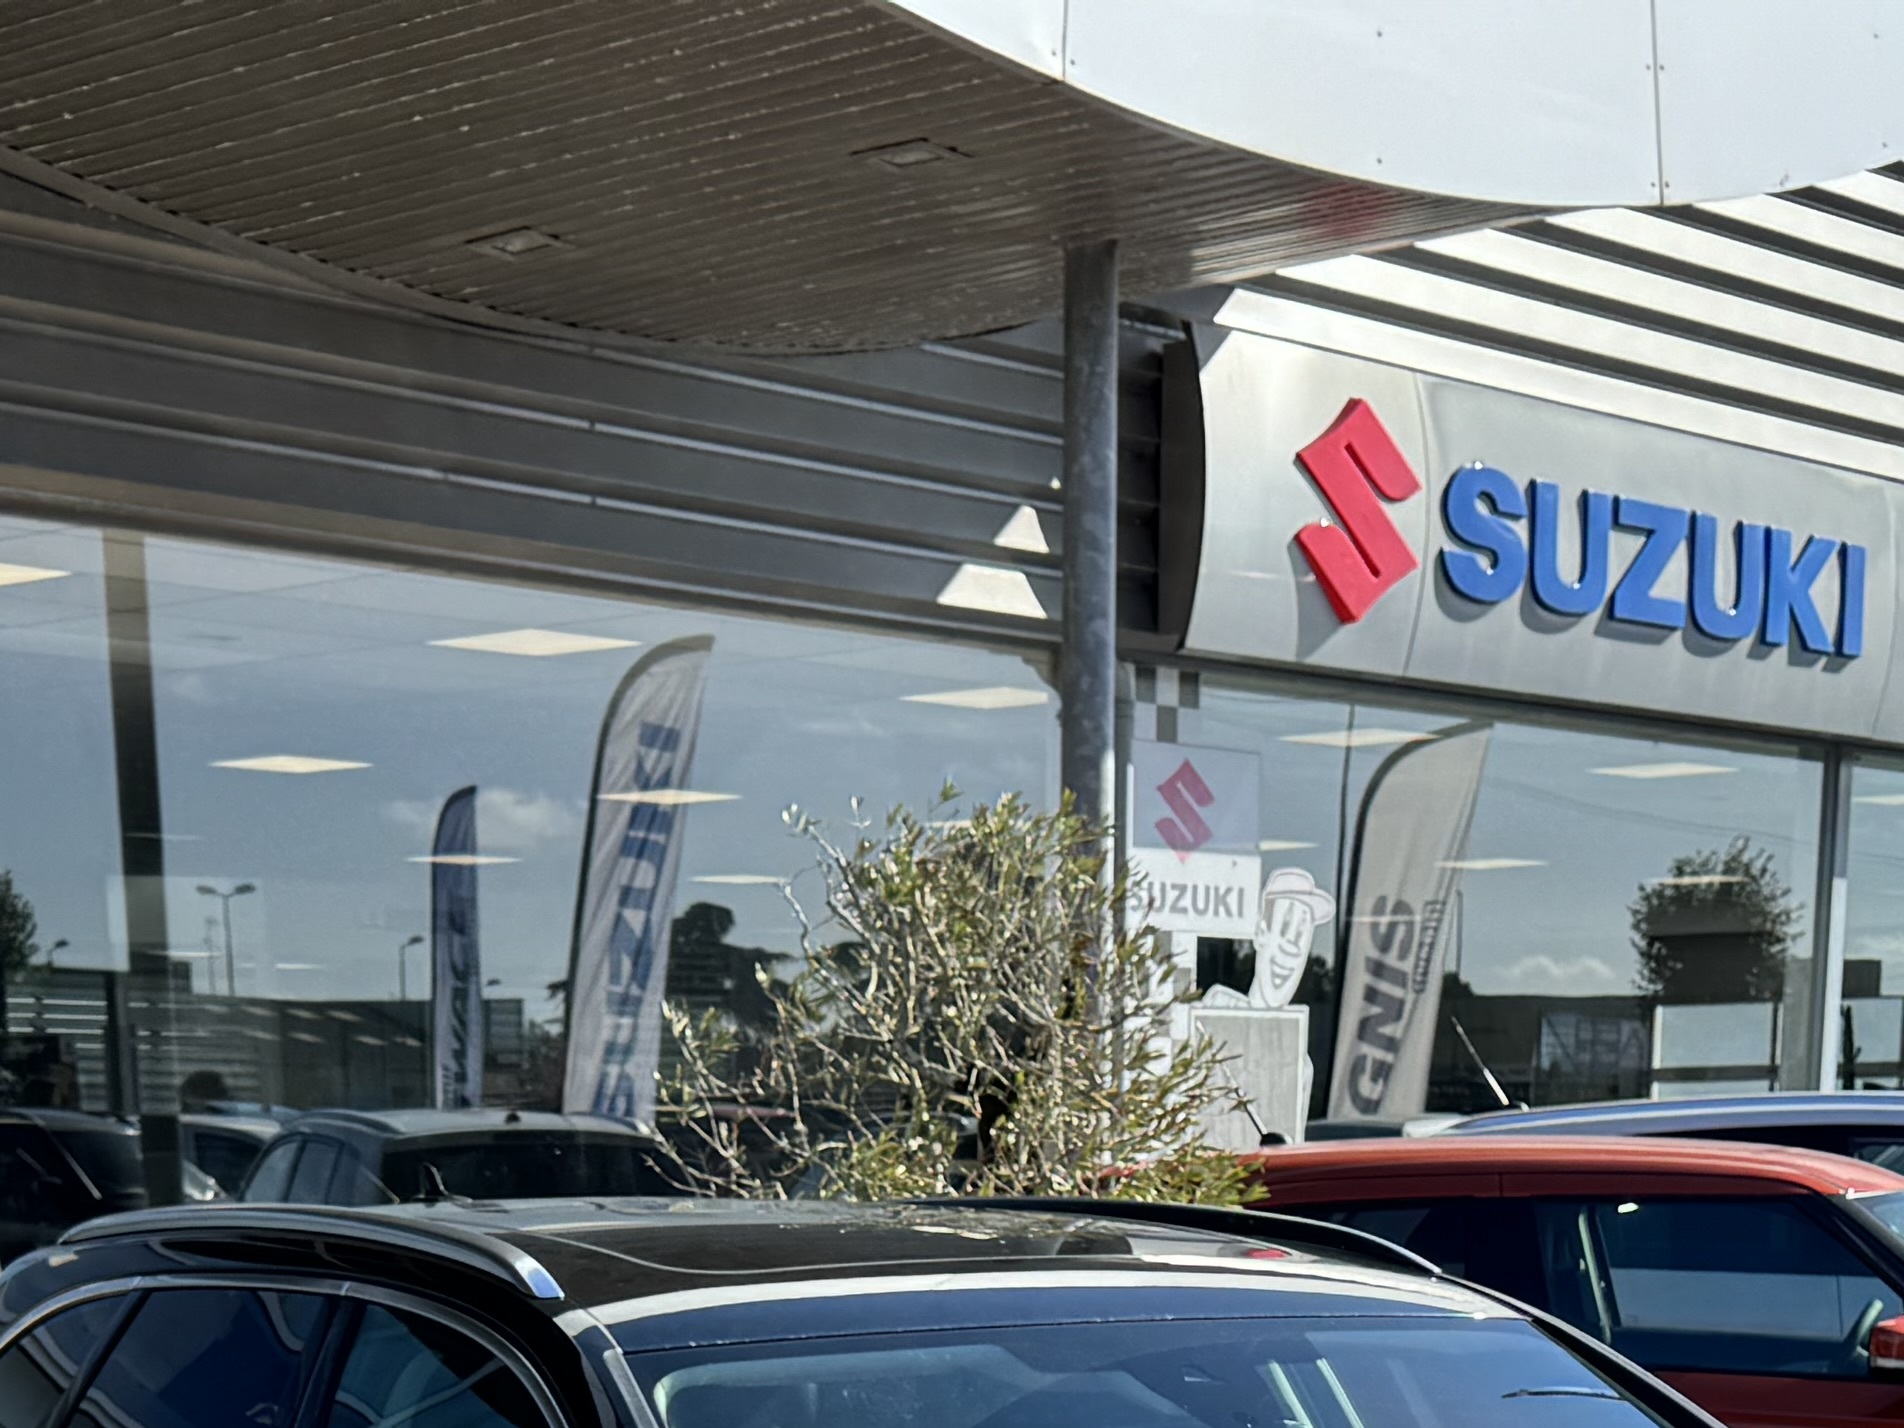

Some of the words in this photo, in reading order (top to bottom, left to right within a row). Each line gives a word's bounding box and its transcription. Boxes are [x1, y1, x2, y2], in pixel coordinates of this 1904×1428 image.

[1437, 461, 1868, 660] SUZUKI
[1129, 881, 1246, 920] SUZUKI
[1348, 894, 1417, 1116] GNIS
